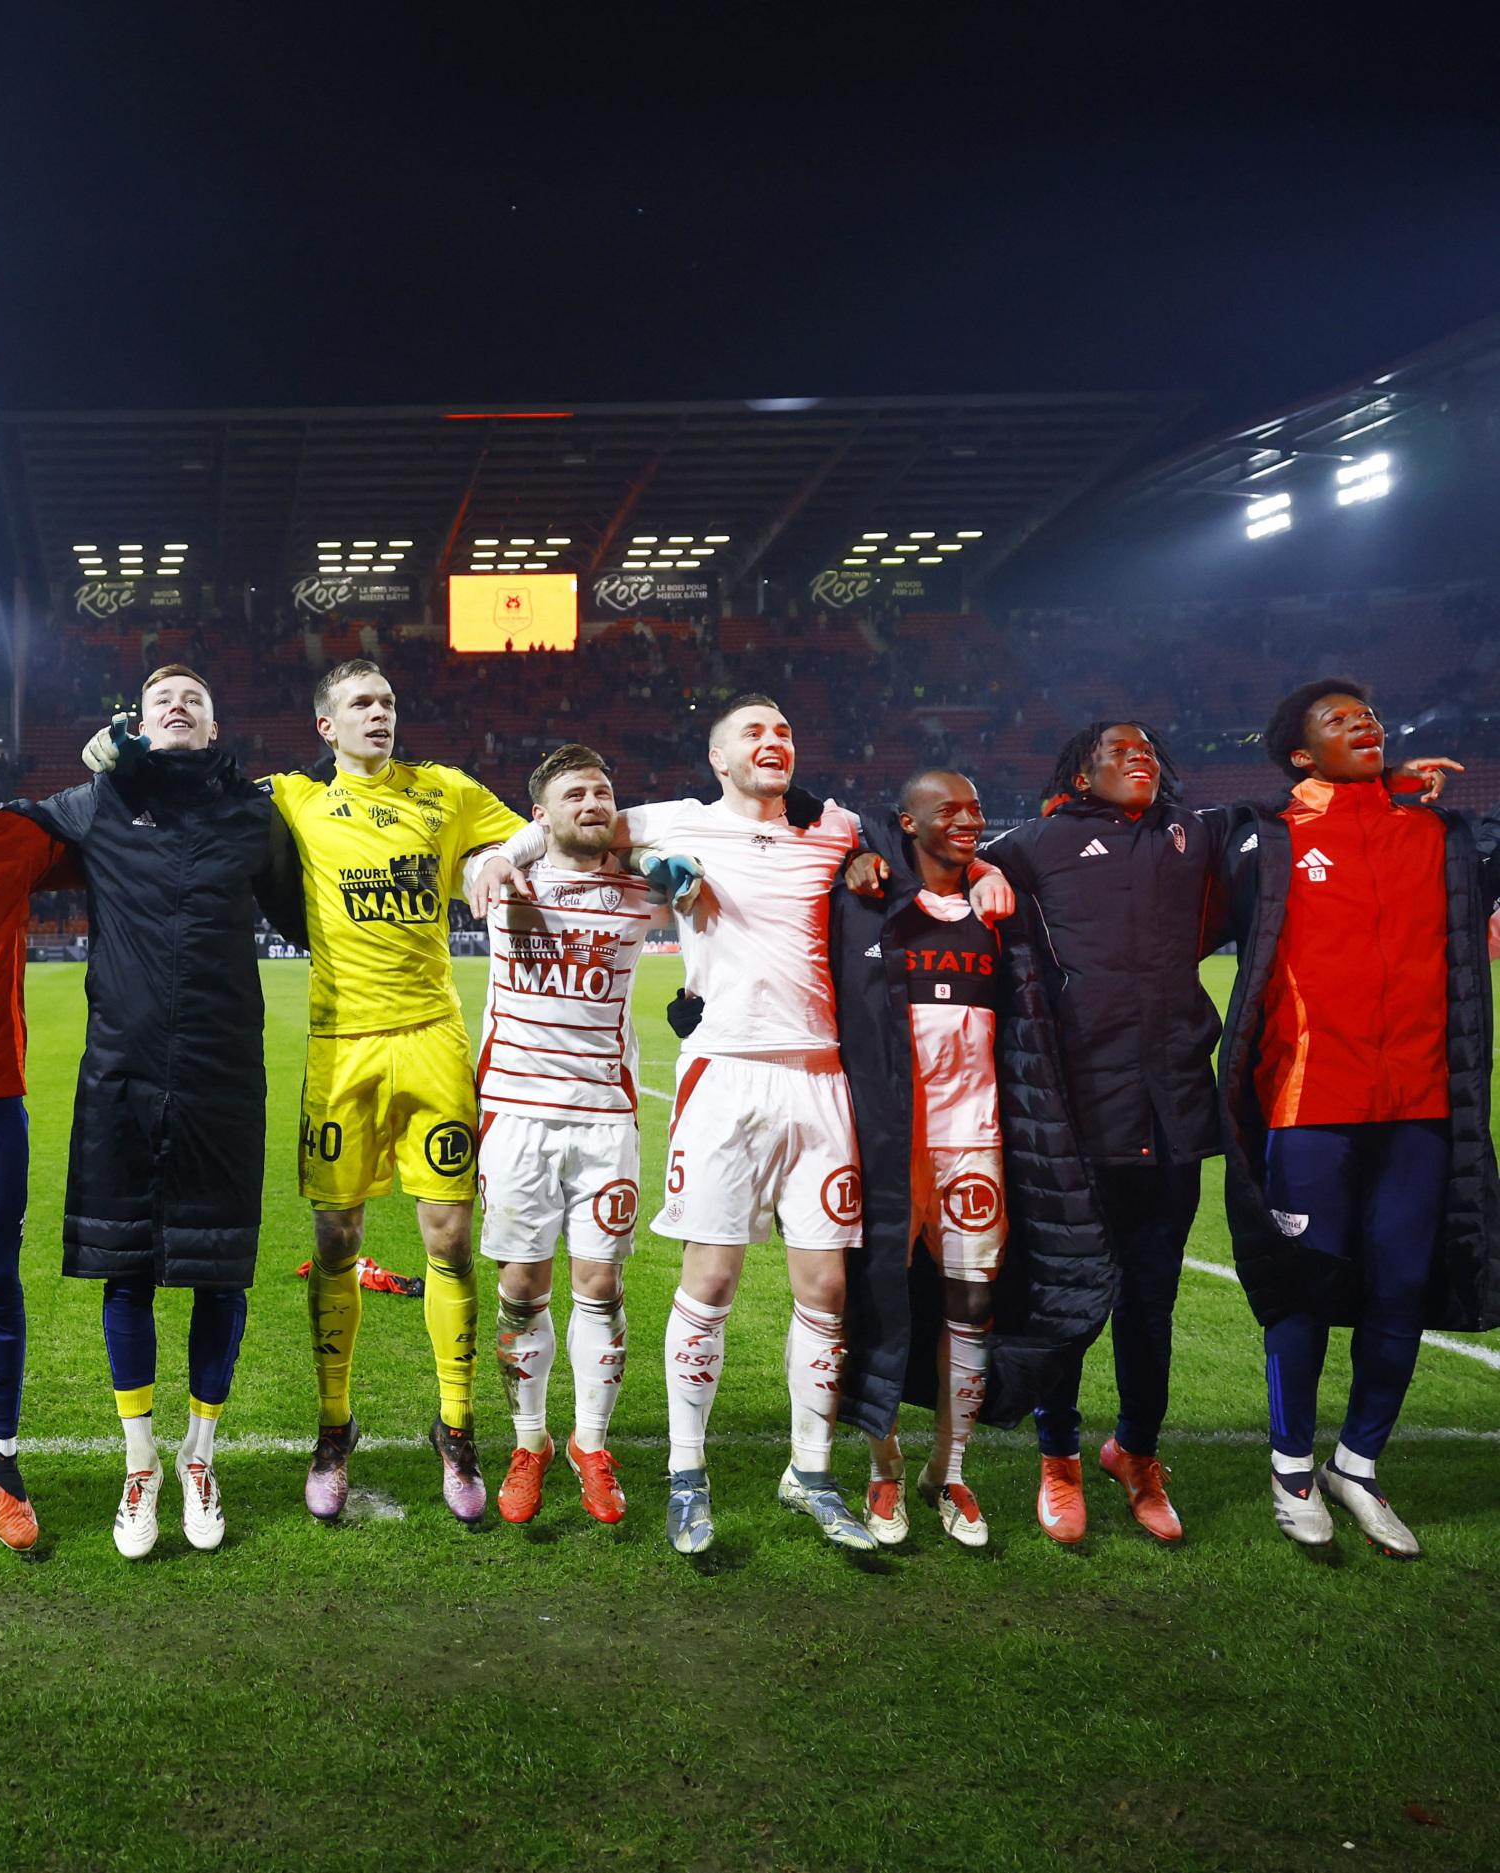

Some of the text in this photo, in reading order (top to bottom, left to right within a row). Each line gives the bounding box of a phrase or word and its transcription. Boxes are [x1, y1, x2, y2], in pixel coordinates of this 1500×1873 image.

[292, 576, 352, 613] Rose
[593, 574, 655, 611] Rose
[377, 814, 400, 828] Cola
[339, 868, 388, 881] YAOURT
[1311, 870, 1323, 880] 37
[551, 884, 586, 899] Breizh
[349, 888, 439, 921] MALO
[558, 895, 581, 908] Cola
[509, 937, 558, 950] YAOURT
[905, 950, 993, 975] STATS
[515, 962, 610, 1001] MALO
[940, 986, 946, 996] 9
[303, 1115, 342, 1163] 40
[668, 1150, 685, 1194] 5
[674, 1351, 720, 1367] BSP
[956, 1388, 986, 1400] BS
